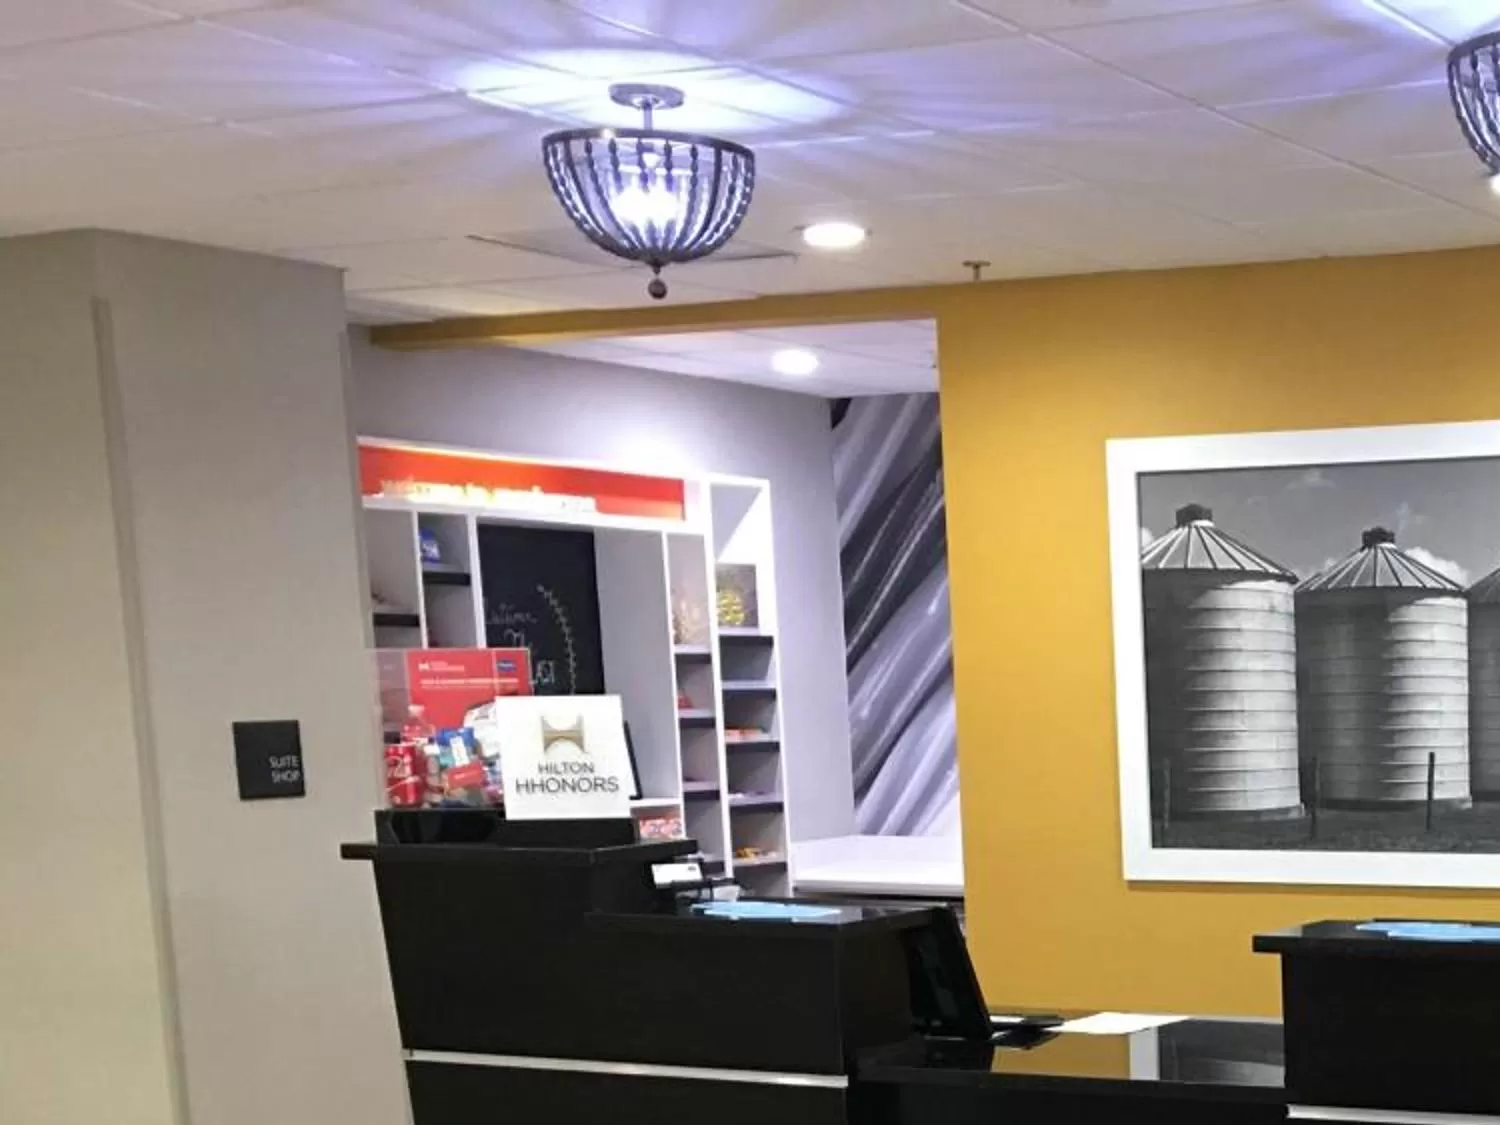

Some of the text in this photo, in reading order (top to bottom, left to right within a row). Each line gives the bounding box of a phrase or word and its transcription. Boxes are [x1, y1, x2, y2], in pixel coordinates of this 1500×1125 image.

[268, 755, 300, 769] SUITE
[537, 761, 595, 775] HILTON
[271, 769, 301, 784] SHOP
[515, 776, 620, 794] HHONORS
